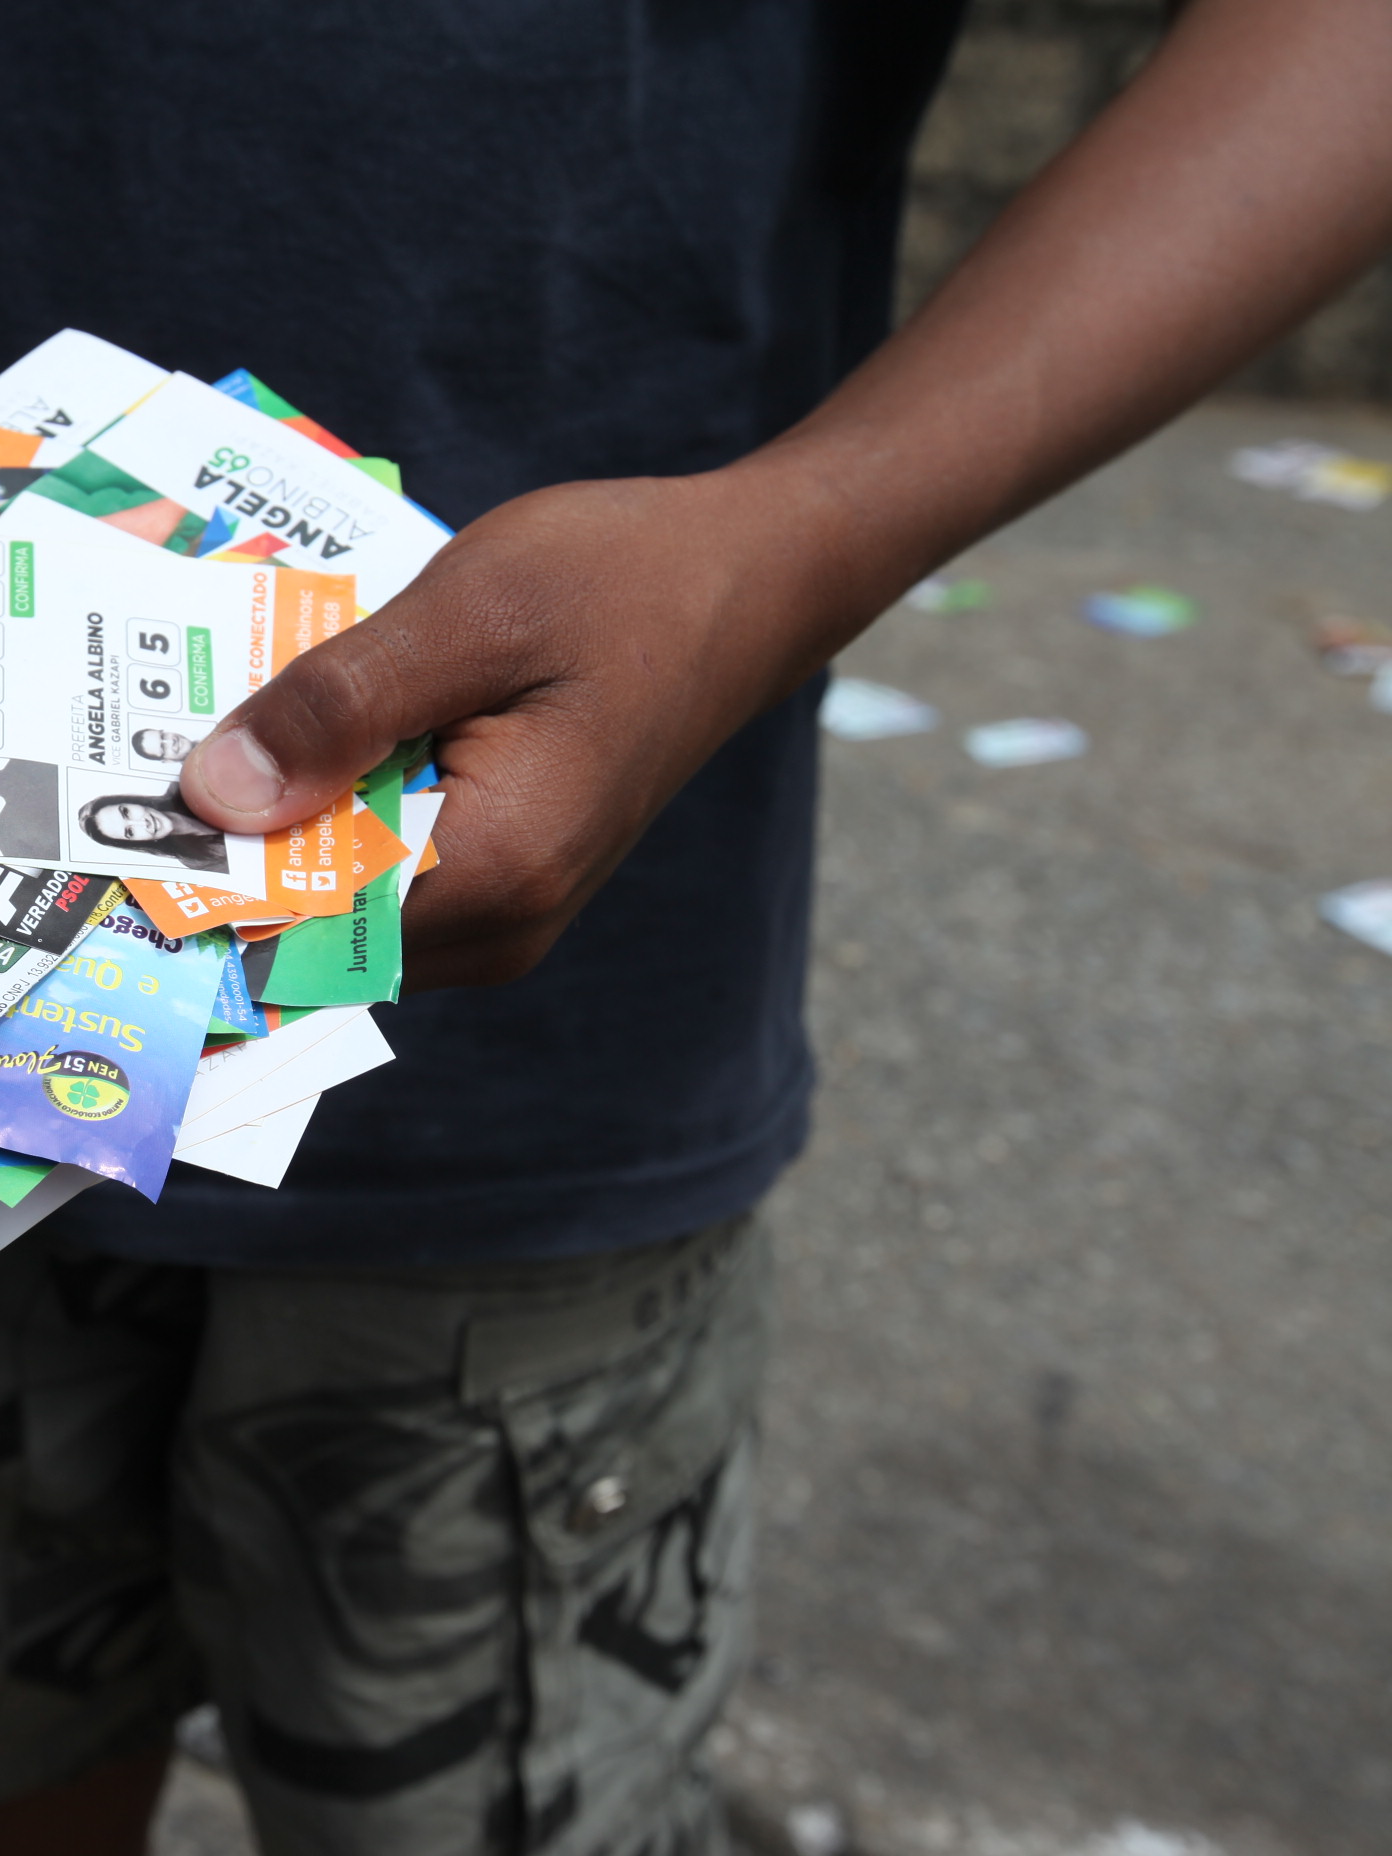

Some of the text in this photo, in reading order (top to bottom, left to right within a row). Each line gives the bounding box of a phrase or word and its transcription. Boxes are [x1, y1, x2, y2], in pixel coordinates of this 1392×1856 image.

[194, 465, 354, 560] ANGELA
[15, 547, 29, 612] CONFIRMA
[249, 572, 268, 669] CONECTADO
[87, 612, 106, 765] ANGELA ALBINO
[139, 632, 171, 701] 6 5
[192, 634, 209, 707] CONFIRMA
[72, 694, 85, 762] PREFEITA
[110, 654, 122, 766] VICE GABRIEL KAZAPI
[16, 870, 73, 938] VEREADO
[55, 874, 90, 913] PSOL
[347, 918, 367, 973] Juntos
[2, 978, 30, 1002] CNPJ
[138, 975, 159, 995] e
[64, 1055, 119, 1080] PEN 51
[102, 1098, 124, 1117] PARTIDO
